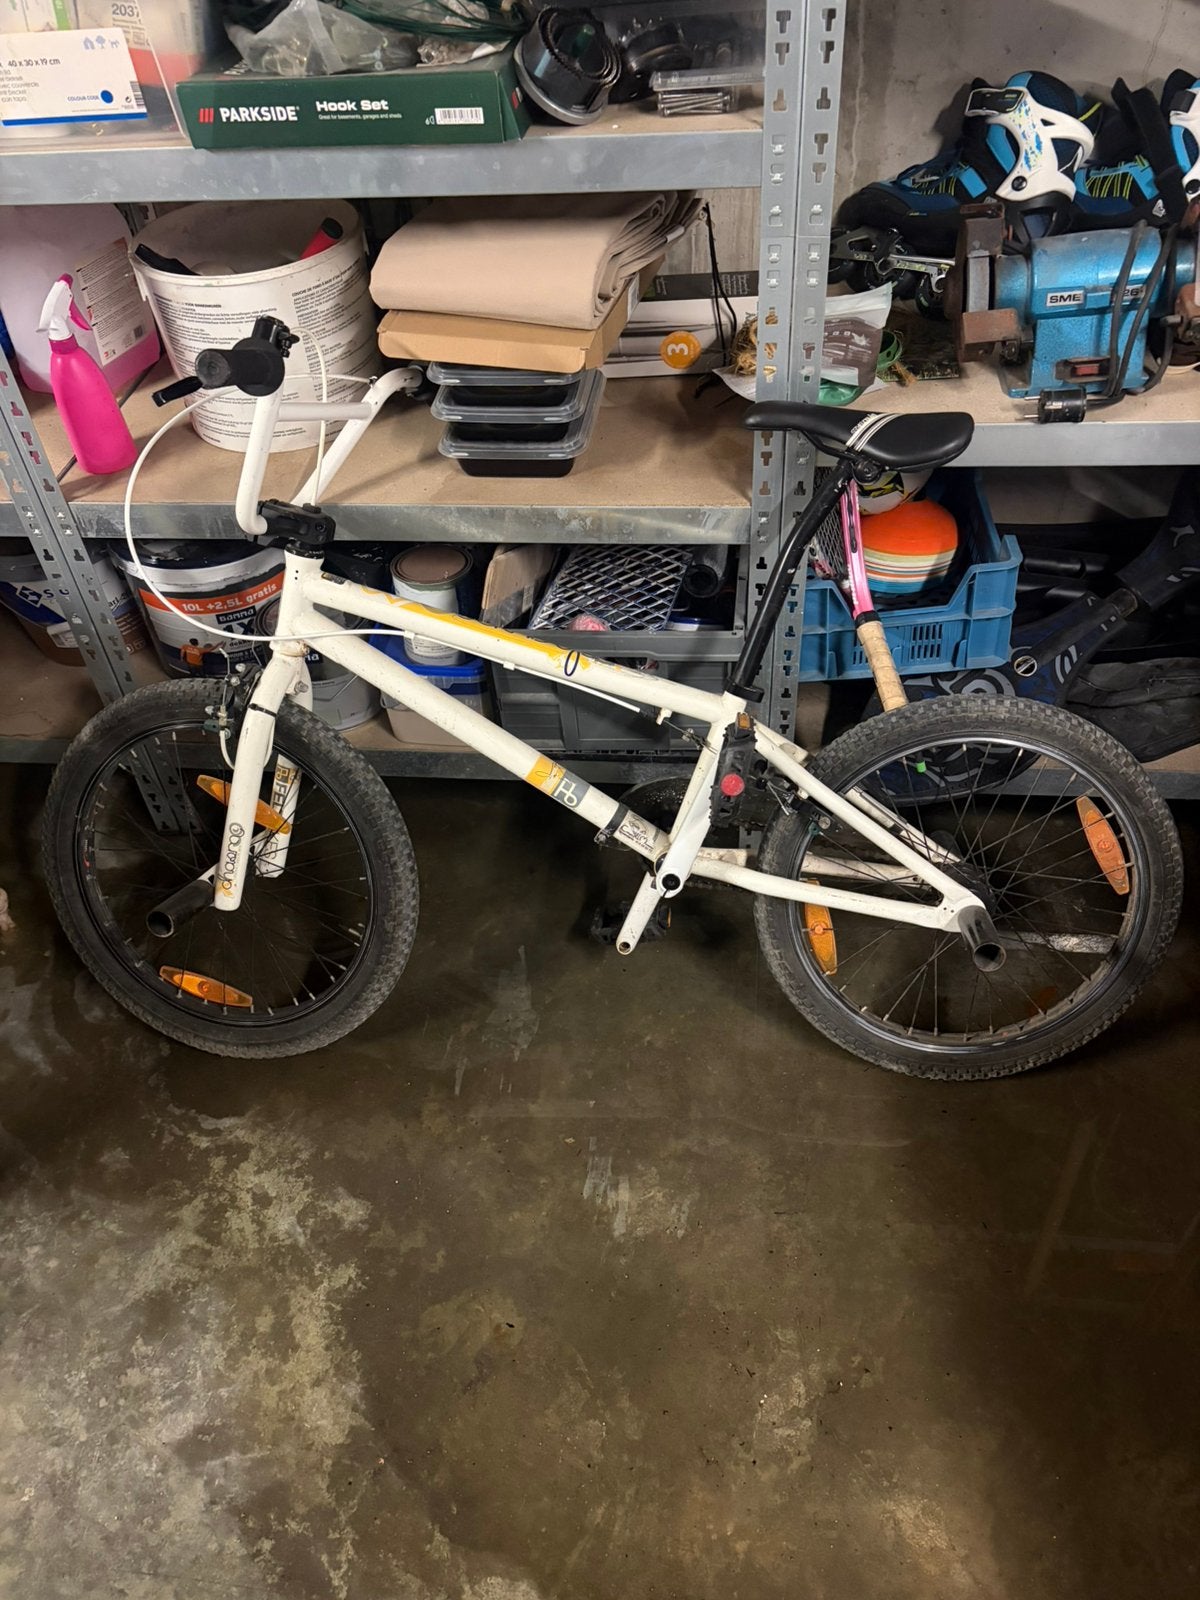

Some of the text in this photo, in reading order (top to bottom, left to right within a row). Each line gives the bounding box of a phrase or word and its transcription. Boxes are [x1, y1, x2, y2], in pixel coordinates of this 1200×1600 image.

[316, 100, 389, 111] Hook Set
[219, 106, 298, 122] PARKSIDE
[1049, 293, 1081, 304] SME
[182, 603, 204, 612] 10L
[246, 584, 277, 603] gratis
[271, 782, 287, 813] FEL
